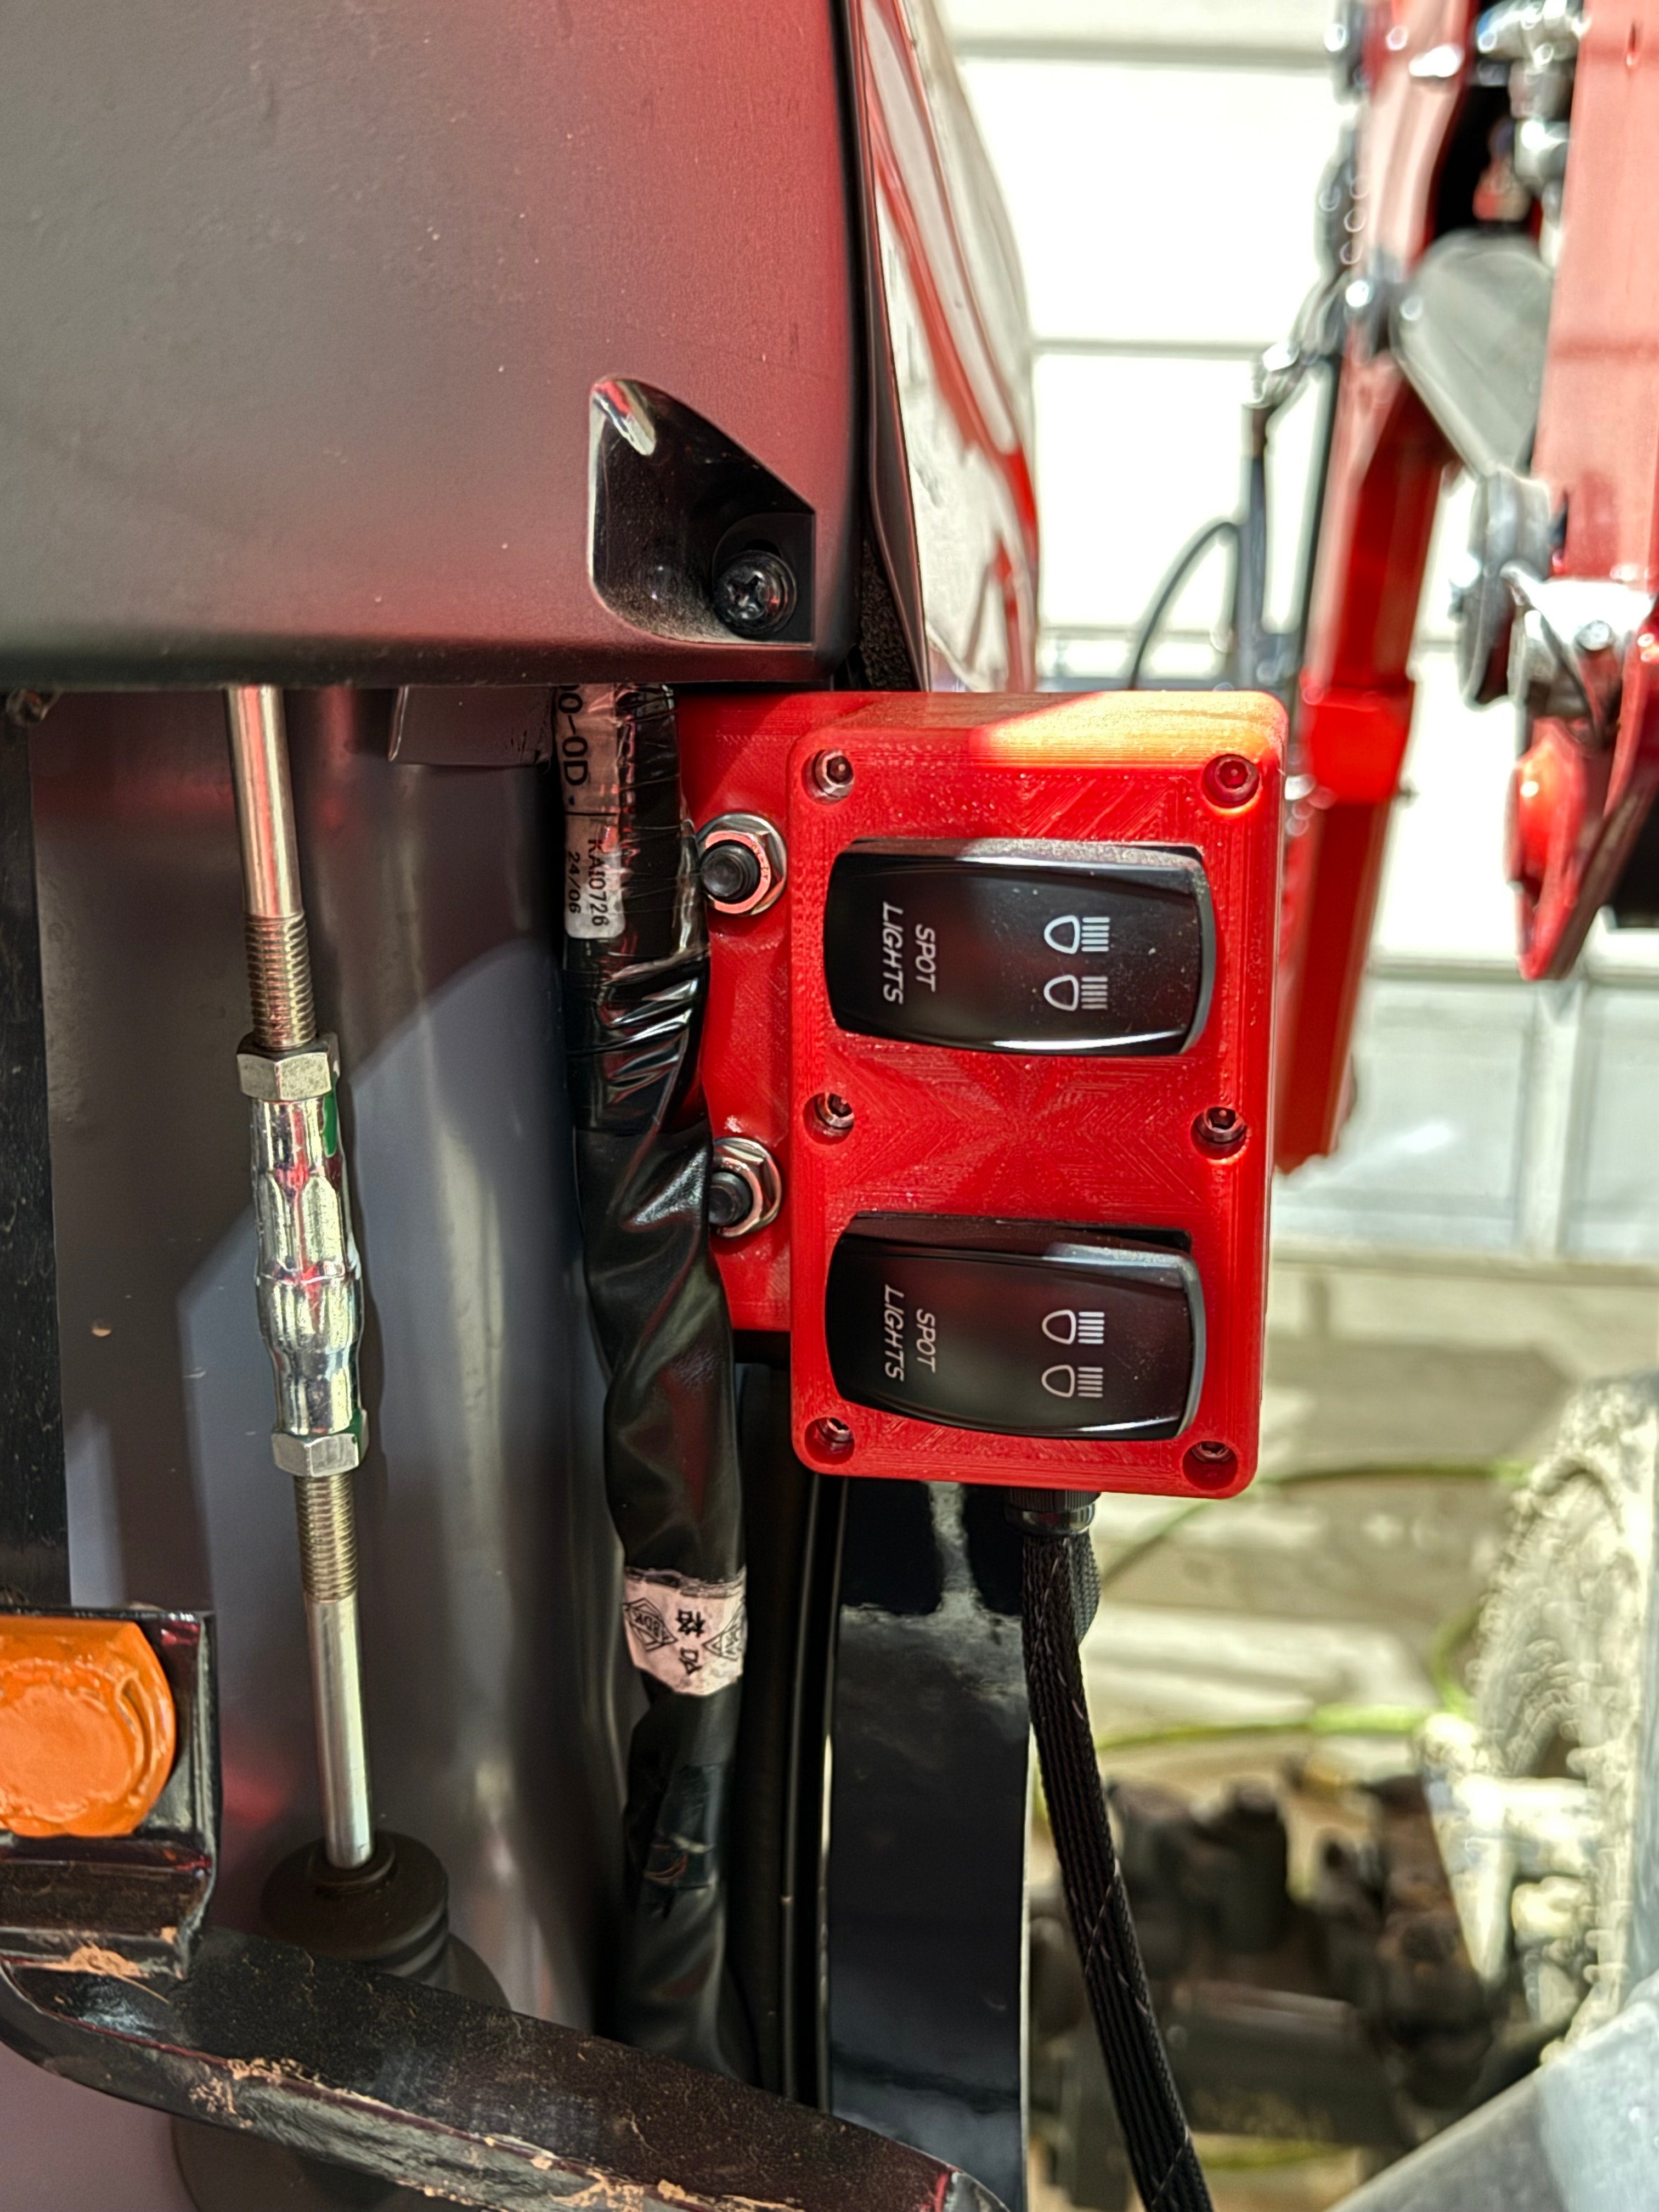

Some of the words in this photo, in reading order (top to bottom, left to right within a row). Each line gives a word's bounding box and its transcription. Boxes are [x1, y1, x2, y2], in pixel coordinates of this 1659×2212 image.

[558, 685, 588, 786] 0-0D
[568, 851, 582, 914] 24/06
[882, 901, 904, 1004] LIGHTS
[915, 924, 936, 992] SPOT
[884, 1284, 904, 1381] LIGHTS
[916, 1308, 935, 1373] SPOT
[676, 1609, 706, 1675] 合格
